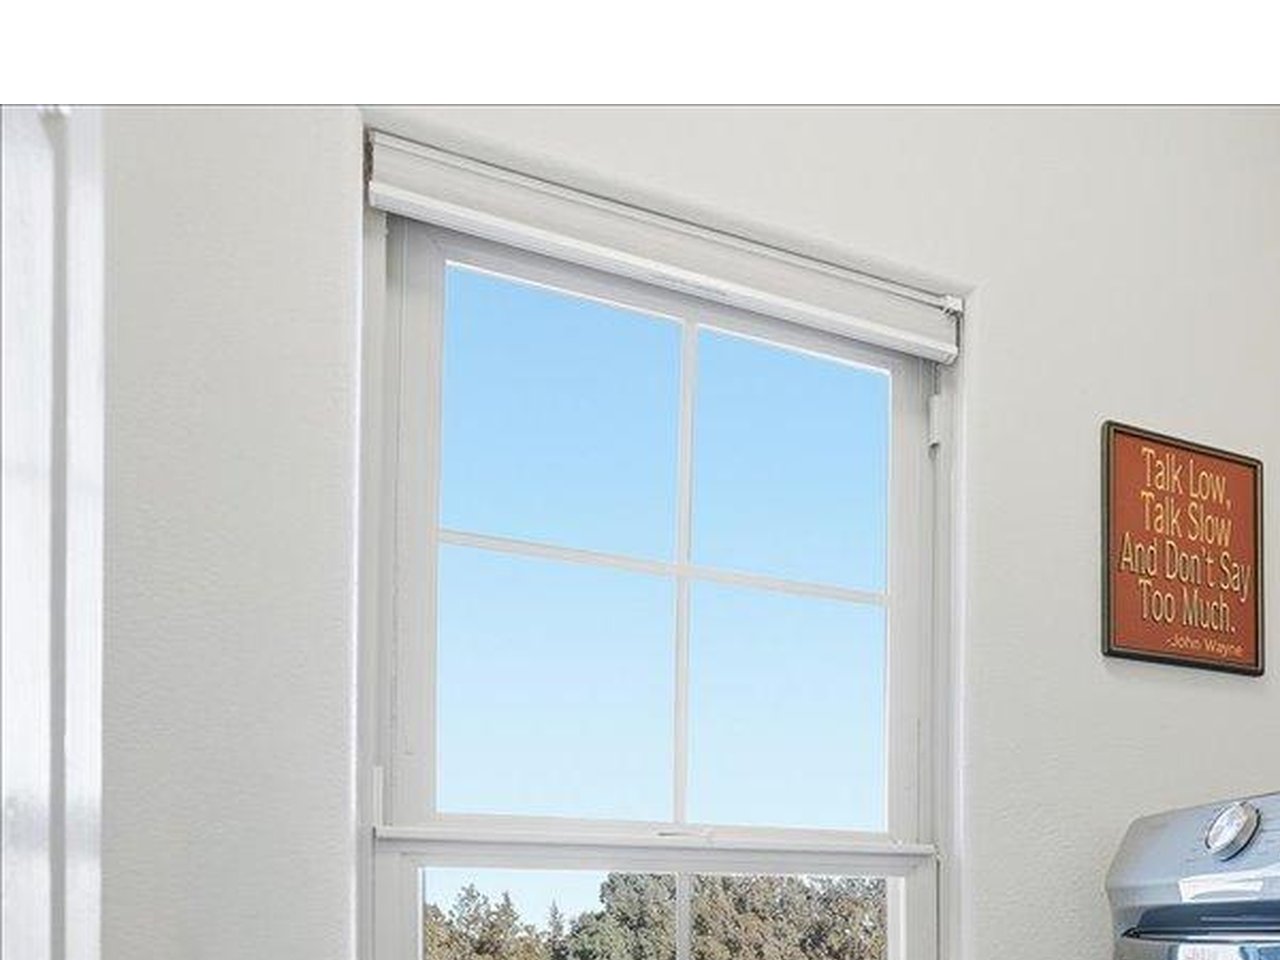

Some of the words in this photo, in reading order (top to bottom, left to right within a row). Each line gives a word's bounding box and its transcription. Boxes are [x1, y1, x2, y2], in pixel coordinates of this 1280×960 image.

[1141, 446, 1183, 494] Talk
[1189, 459, 1231, 510] Low,
[1140, 490, 1182, 538] Talk
[1187, 501, 1232, 547] Slow
[1120, 532, 1157, 576] And
[1165, 540, 1215, 589] Don't
[1220, 551, 1250, 602] Say
[1138, 577, 1175, 623] Too
[1182, 588, 1236, 633] Much.
[1204, 638, 1244, 658] Wayne
